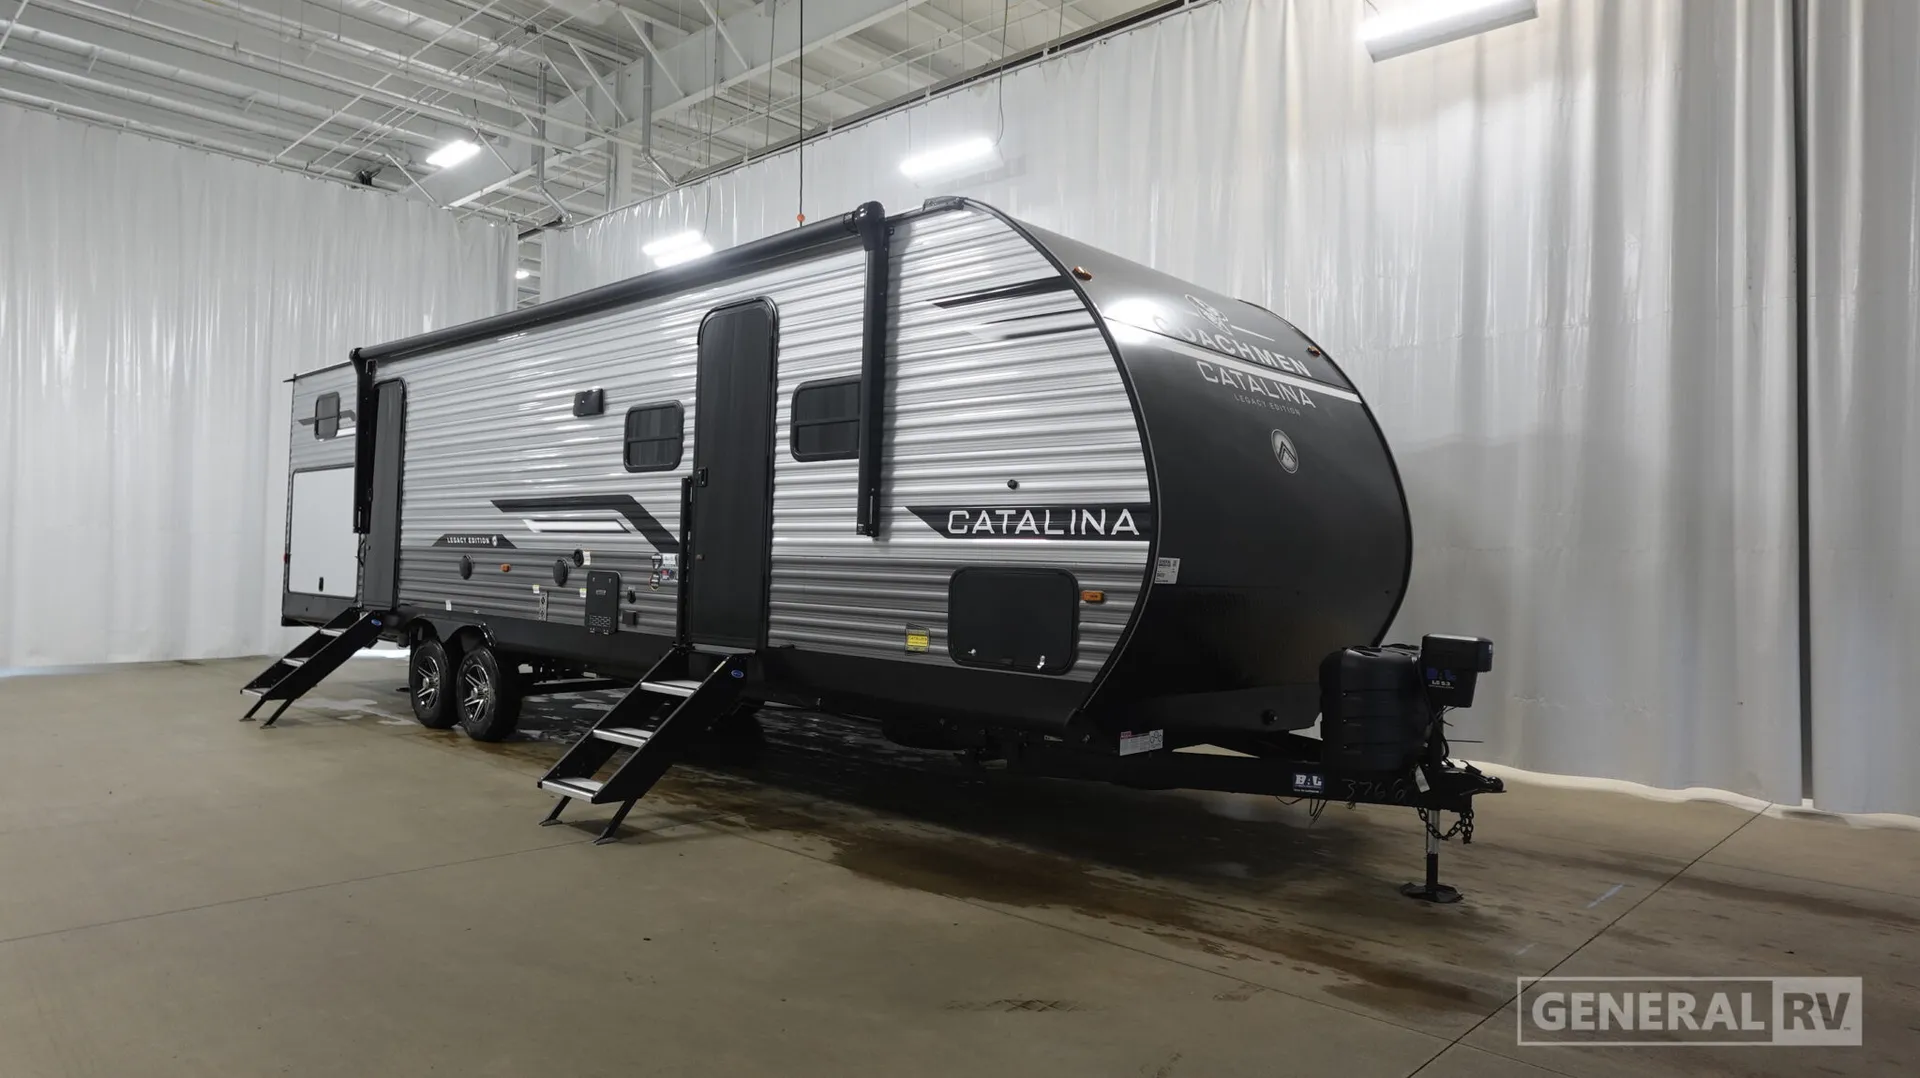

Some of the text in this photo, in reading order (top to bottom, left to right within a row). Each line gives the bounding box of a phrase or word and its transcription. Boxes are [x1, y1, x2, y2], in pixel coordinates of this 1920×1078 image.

[1153, 316, 1312, 377] COACHMEN
[1196, 360, 1316, 408] CATALINA
[1234, 394, 1300, 415] LEGACY EDITION
[948, 508, 1140, 535] CATALINA
